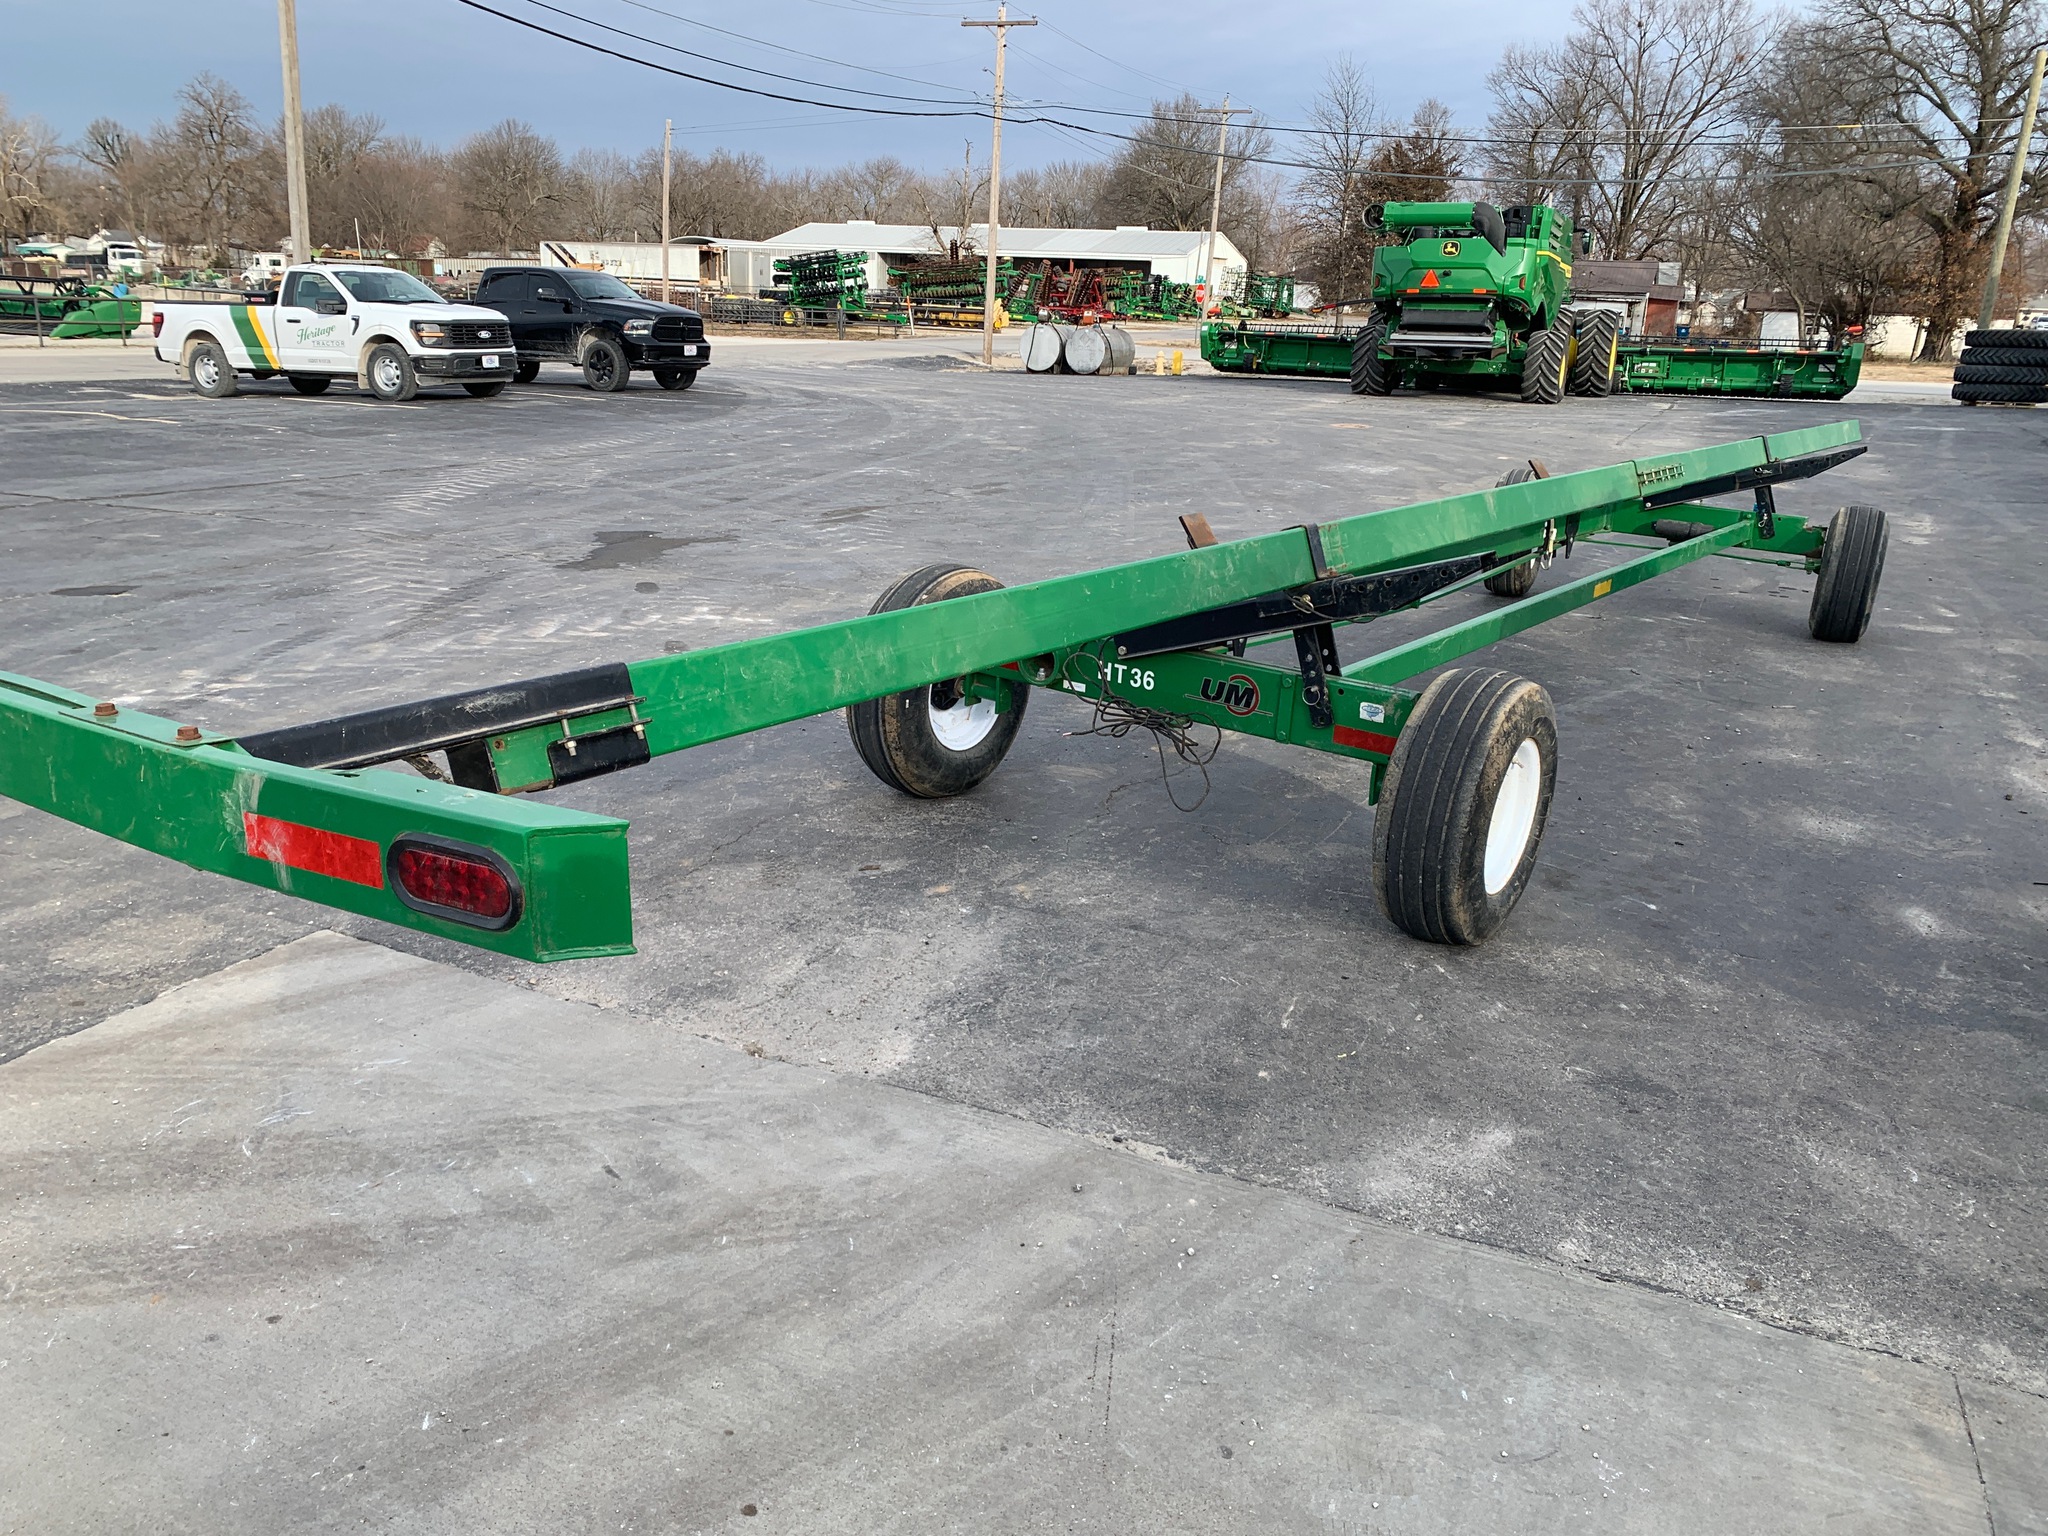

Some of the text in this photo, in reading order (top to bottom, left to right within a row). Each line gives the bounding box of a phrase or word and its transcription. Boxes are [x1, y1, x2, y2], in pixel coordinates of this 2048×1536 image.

[297, 325, 336, 344] Heritage
[1098, 660, 1155, 690] HT 36
[1200, 677, 1255, 708] UM
